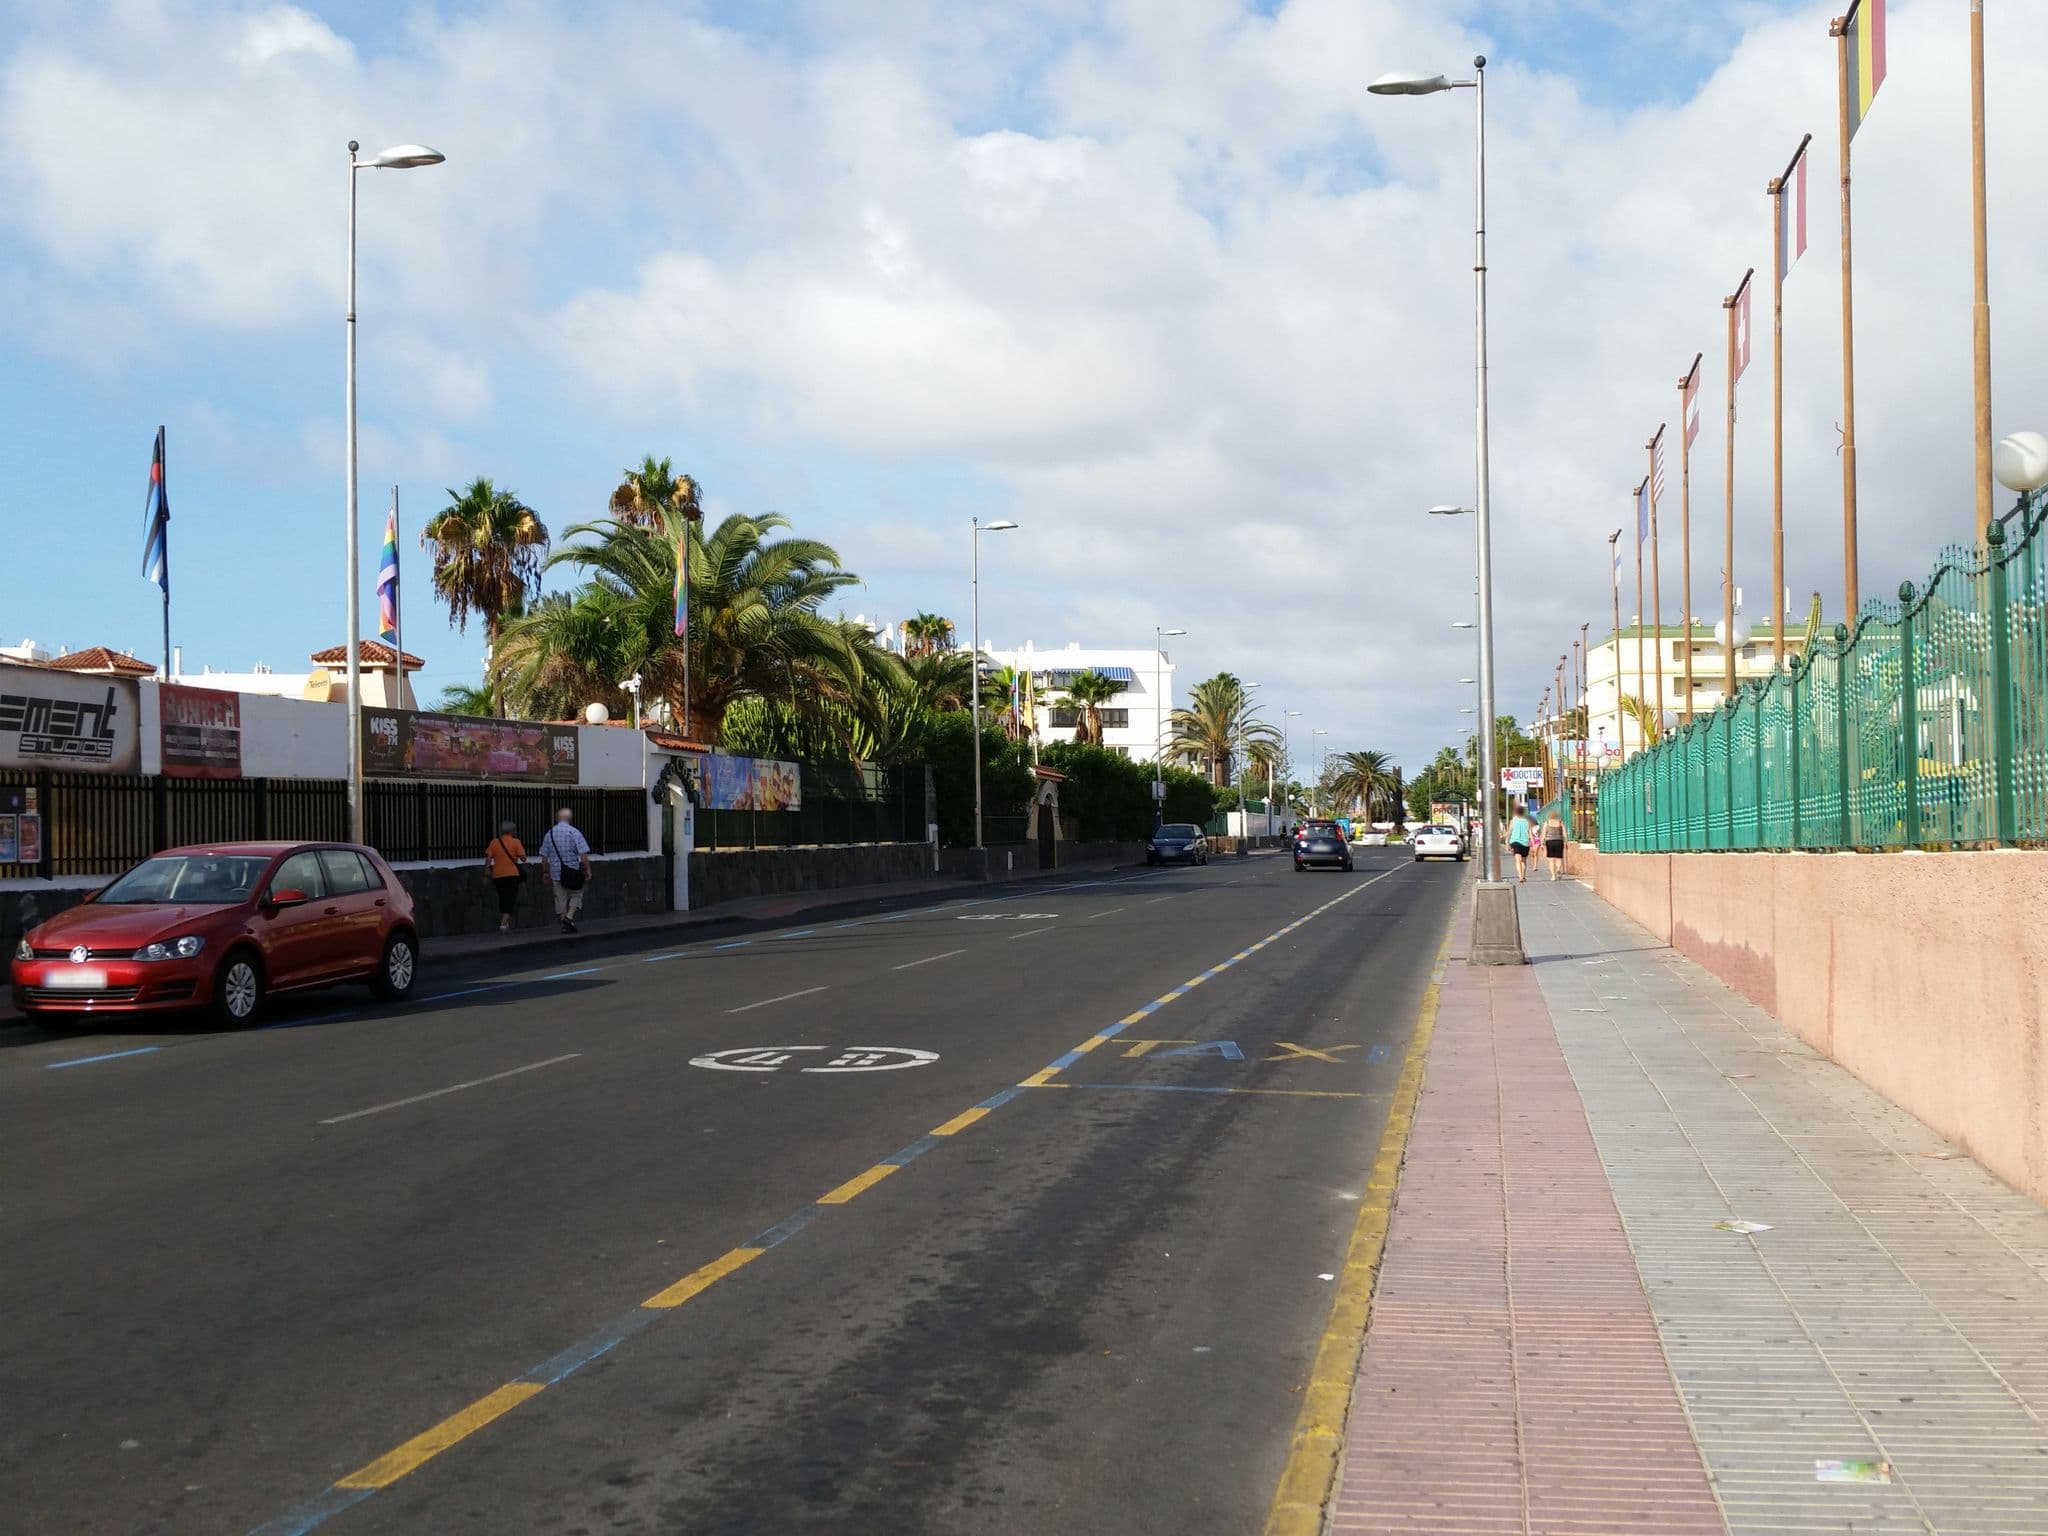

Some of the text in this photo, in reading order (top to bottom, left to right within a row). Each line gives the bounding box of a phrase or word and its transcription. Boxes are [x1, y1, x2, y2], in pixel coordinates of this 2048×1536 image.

[369, 716, 399, 736] KISS
[20, 735, 112, 756] STUDIOS
[553, 736, 575, 751] KISS
[1514, 770, 1543, 779] DOCTOR
[1433, 807, 1459, 815] PRIDE
